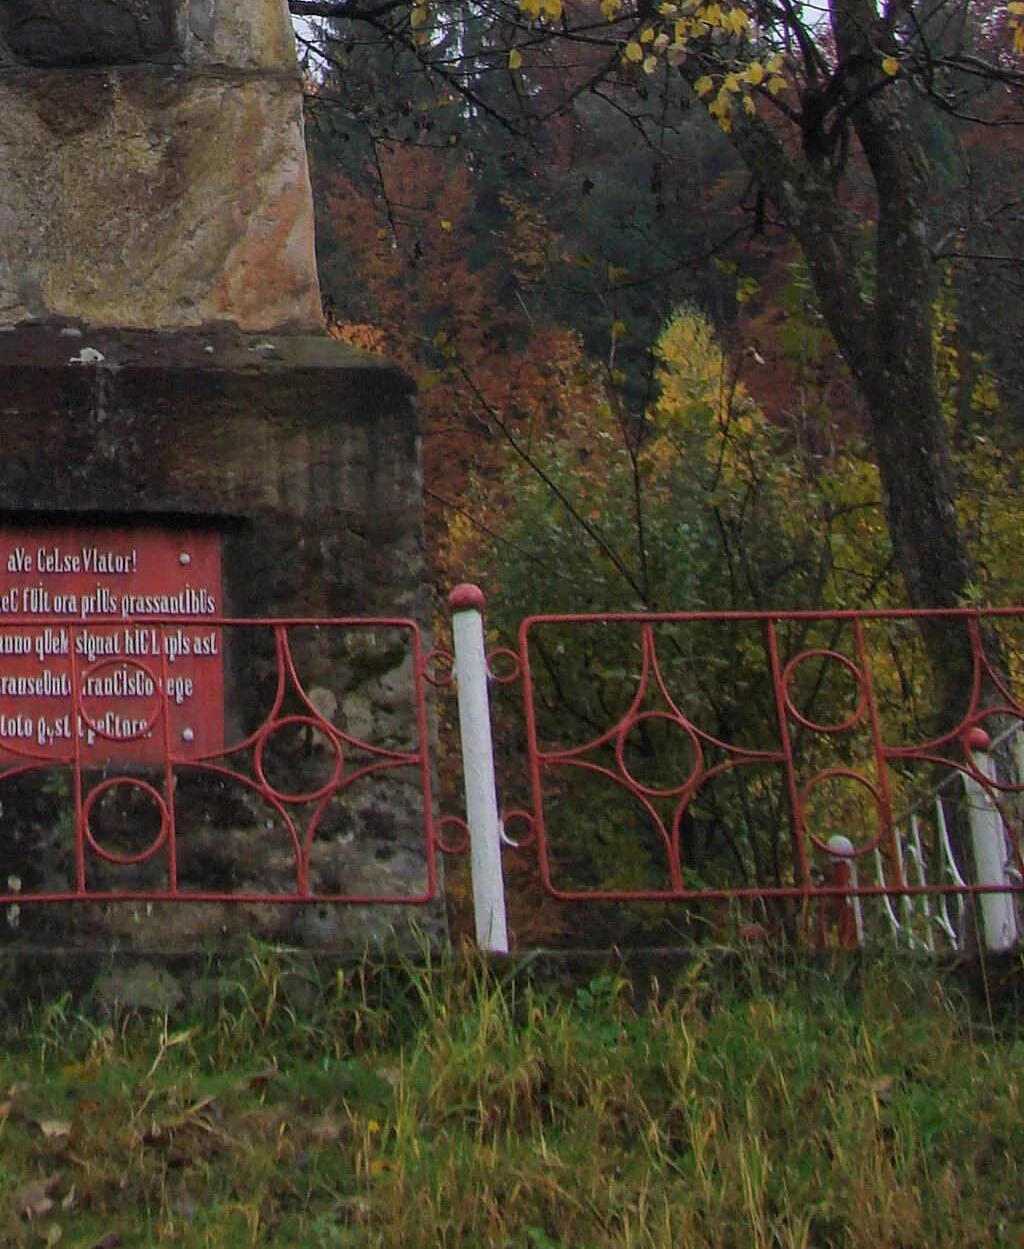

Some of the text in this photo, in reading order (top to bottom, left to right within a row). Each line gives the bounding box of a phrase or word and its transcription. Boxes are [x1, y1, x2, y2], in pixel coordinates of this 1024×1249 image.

[53, 594, 78, 613] ora
[193, 631, 218, 655] ast
[0, 714, 33, 738] toto
